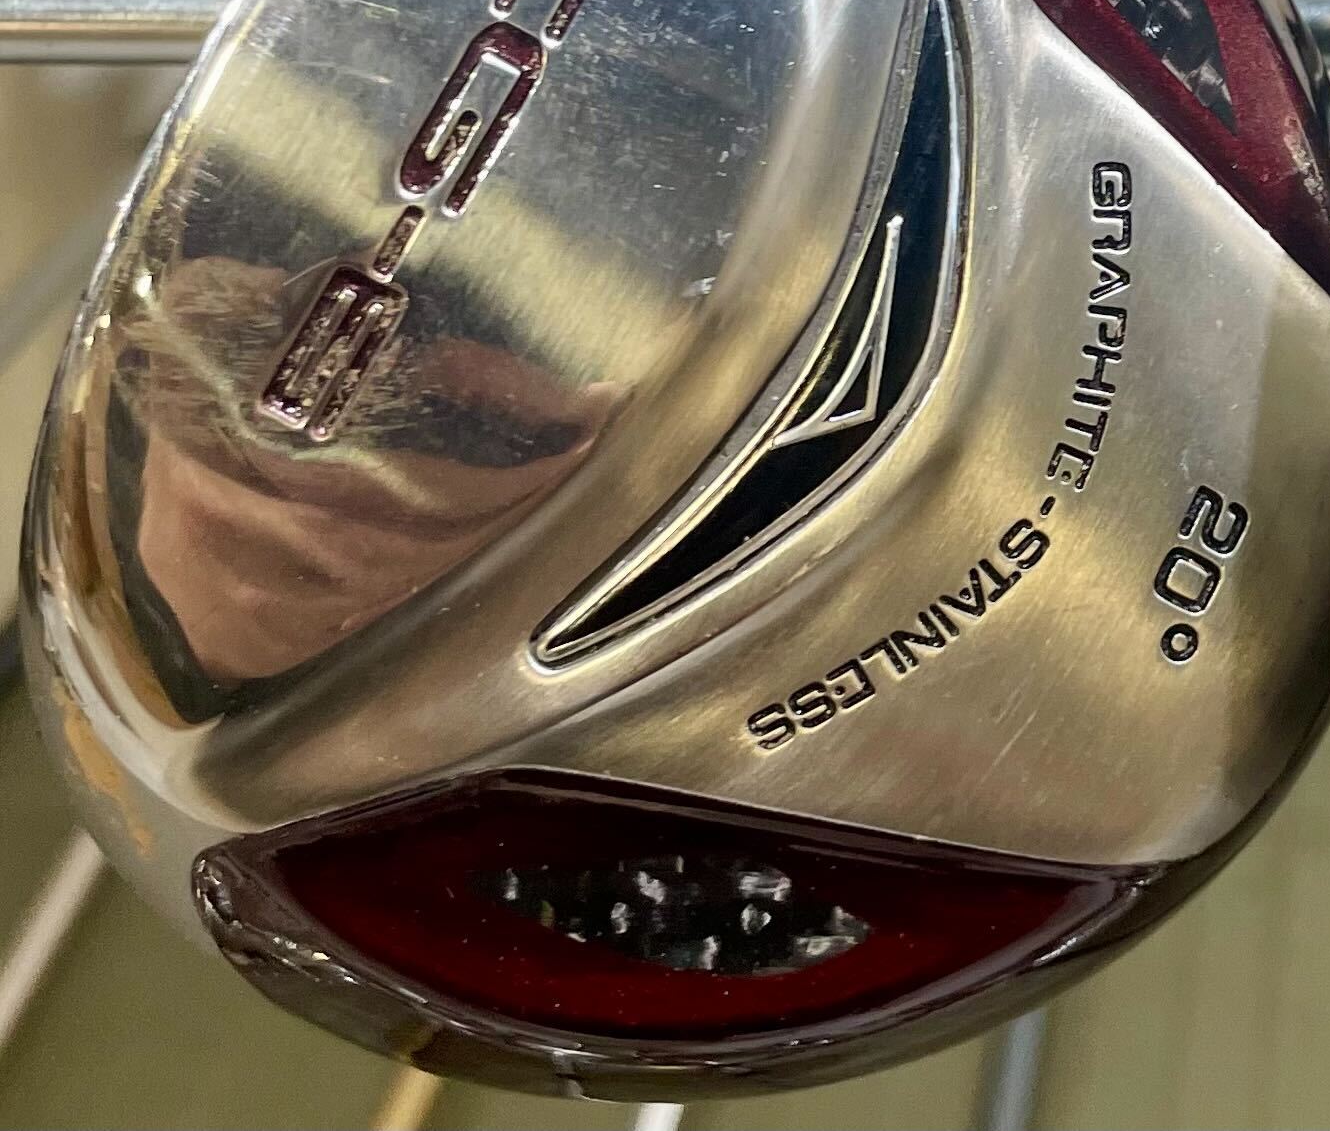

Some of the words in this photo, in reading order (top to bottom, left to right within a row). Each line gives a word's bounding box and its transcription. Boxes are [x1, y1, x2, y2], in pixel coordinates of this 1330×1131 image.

[1046, 161, 1133, 492] GRAPHITE
[746, 517, 1051, 752] STAINLESS
[1153, 484, 1250, 665] 20°
